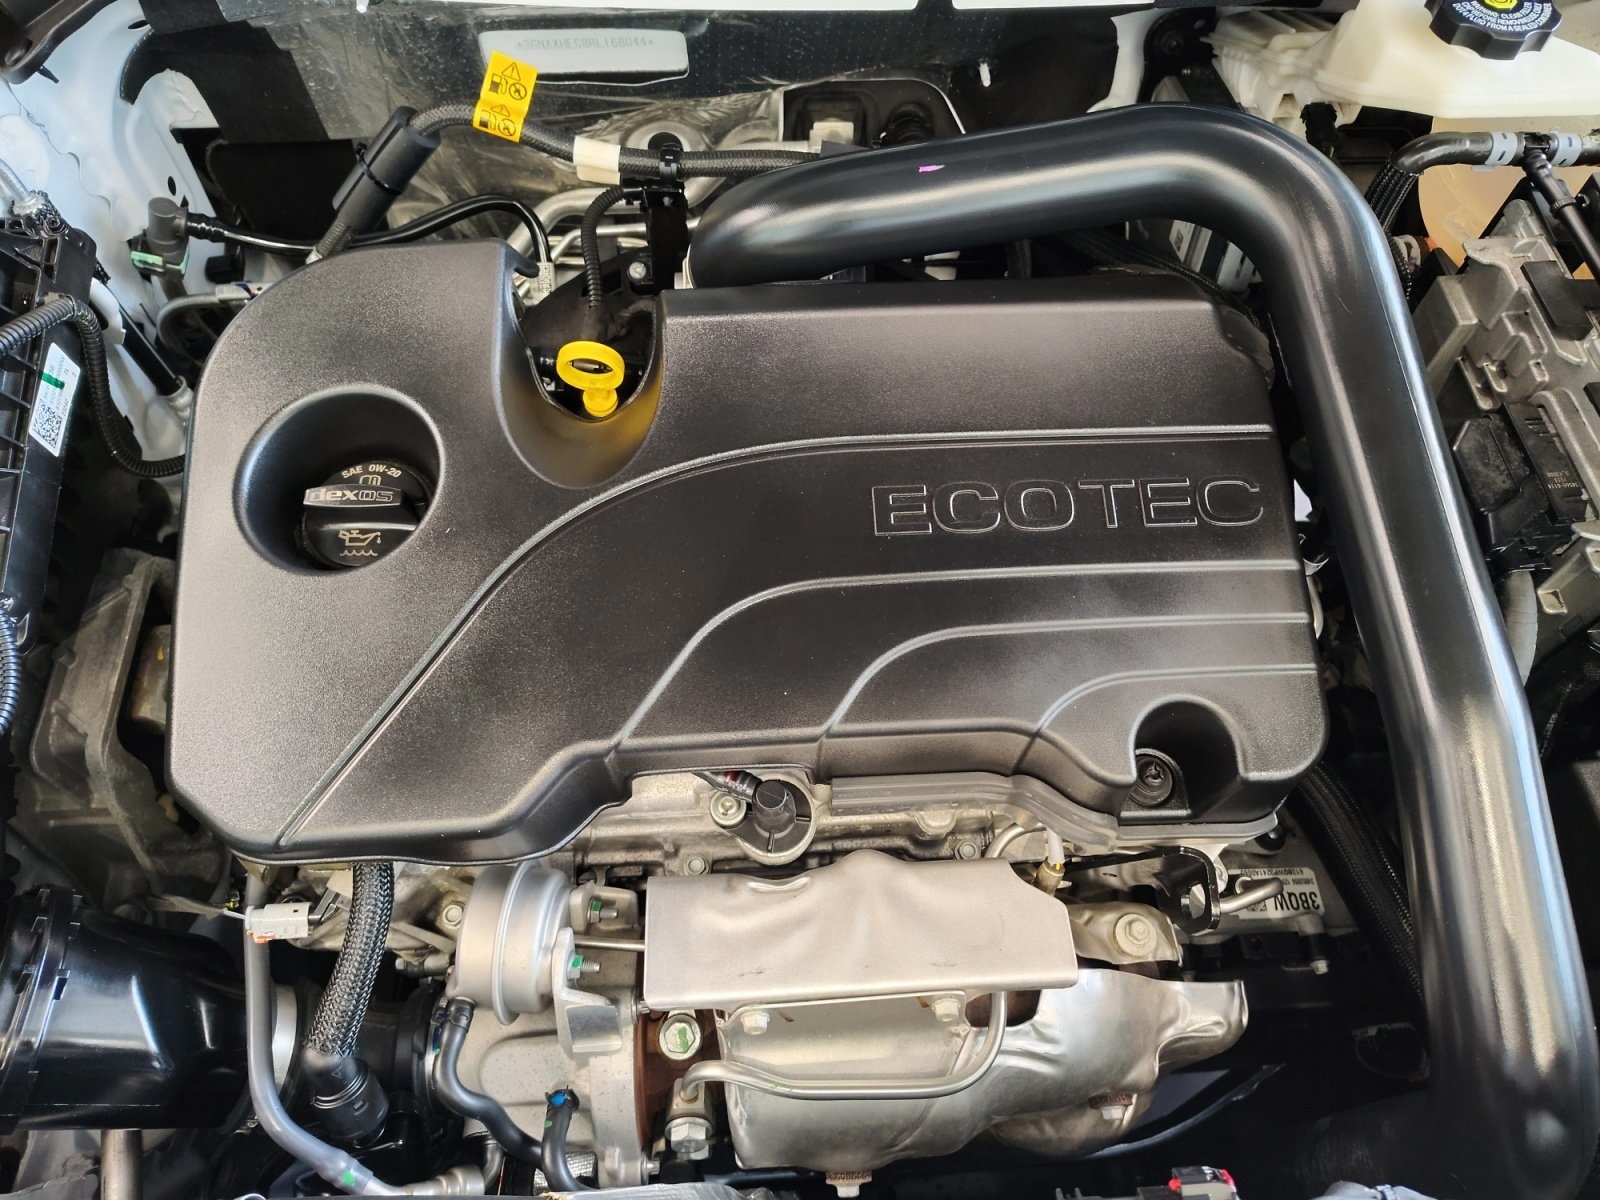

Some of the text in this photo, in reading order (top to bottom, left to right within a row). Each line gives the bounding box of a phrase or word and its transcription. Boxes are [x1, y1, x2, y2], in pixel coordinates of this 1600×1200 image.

[1452, 3, 1467, 13] DOT
[1465, 13, 1486, 25] FLUID
[1486, 21, 1508, 30] FROM
[1512, 22, 1538, 31] SEALED
[1461, 2, 1475, 11] CAP
[1471, 9, 1497, 24] BEFORE
[1500, 12, 1523, 20] CLEAN
[341, 464, 402, 479] SAE 0W-20
[309, 488, 394, 502] dexos
[871, 475, 1264, 536] ECOTEC
[1273, 892, 1321, 911] 3BQW
